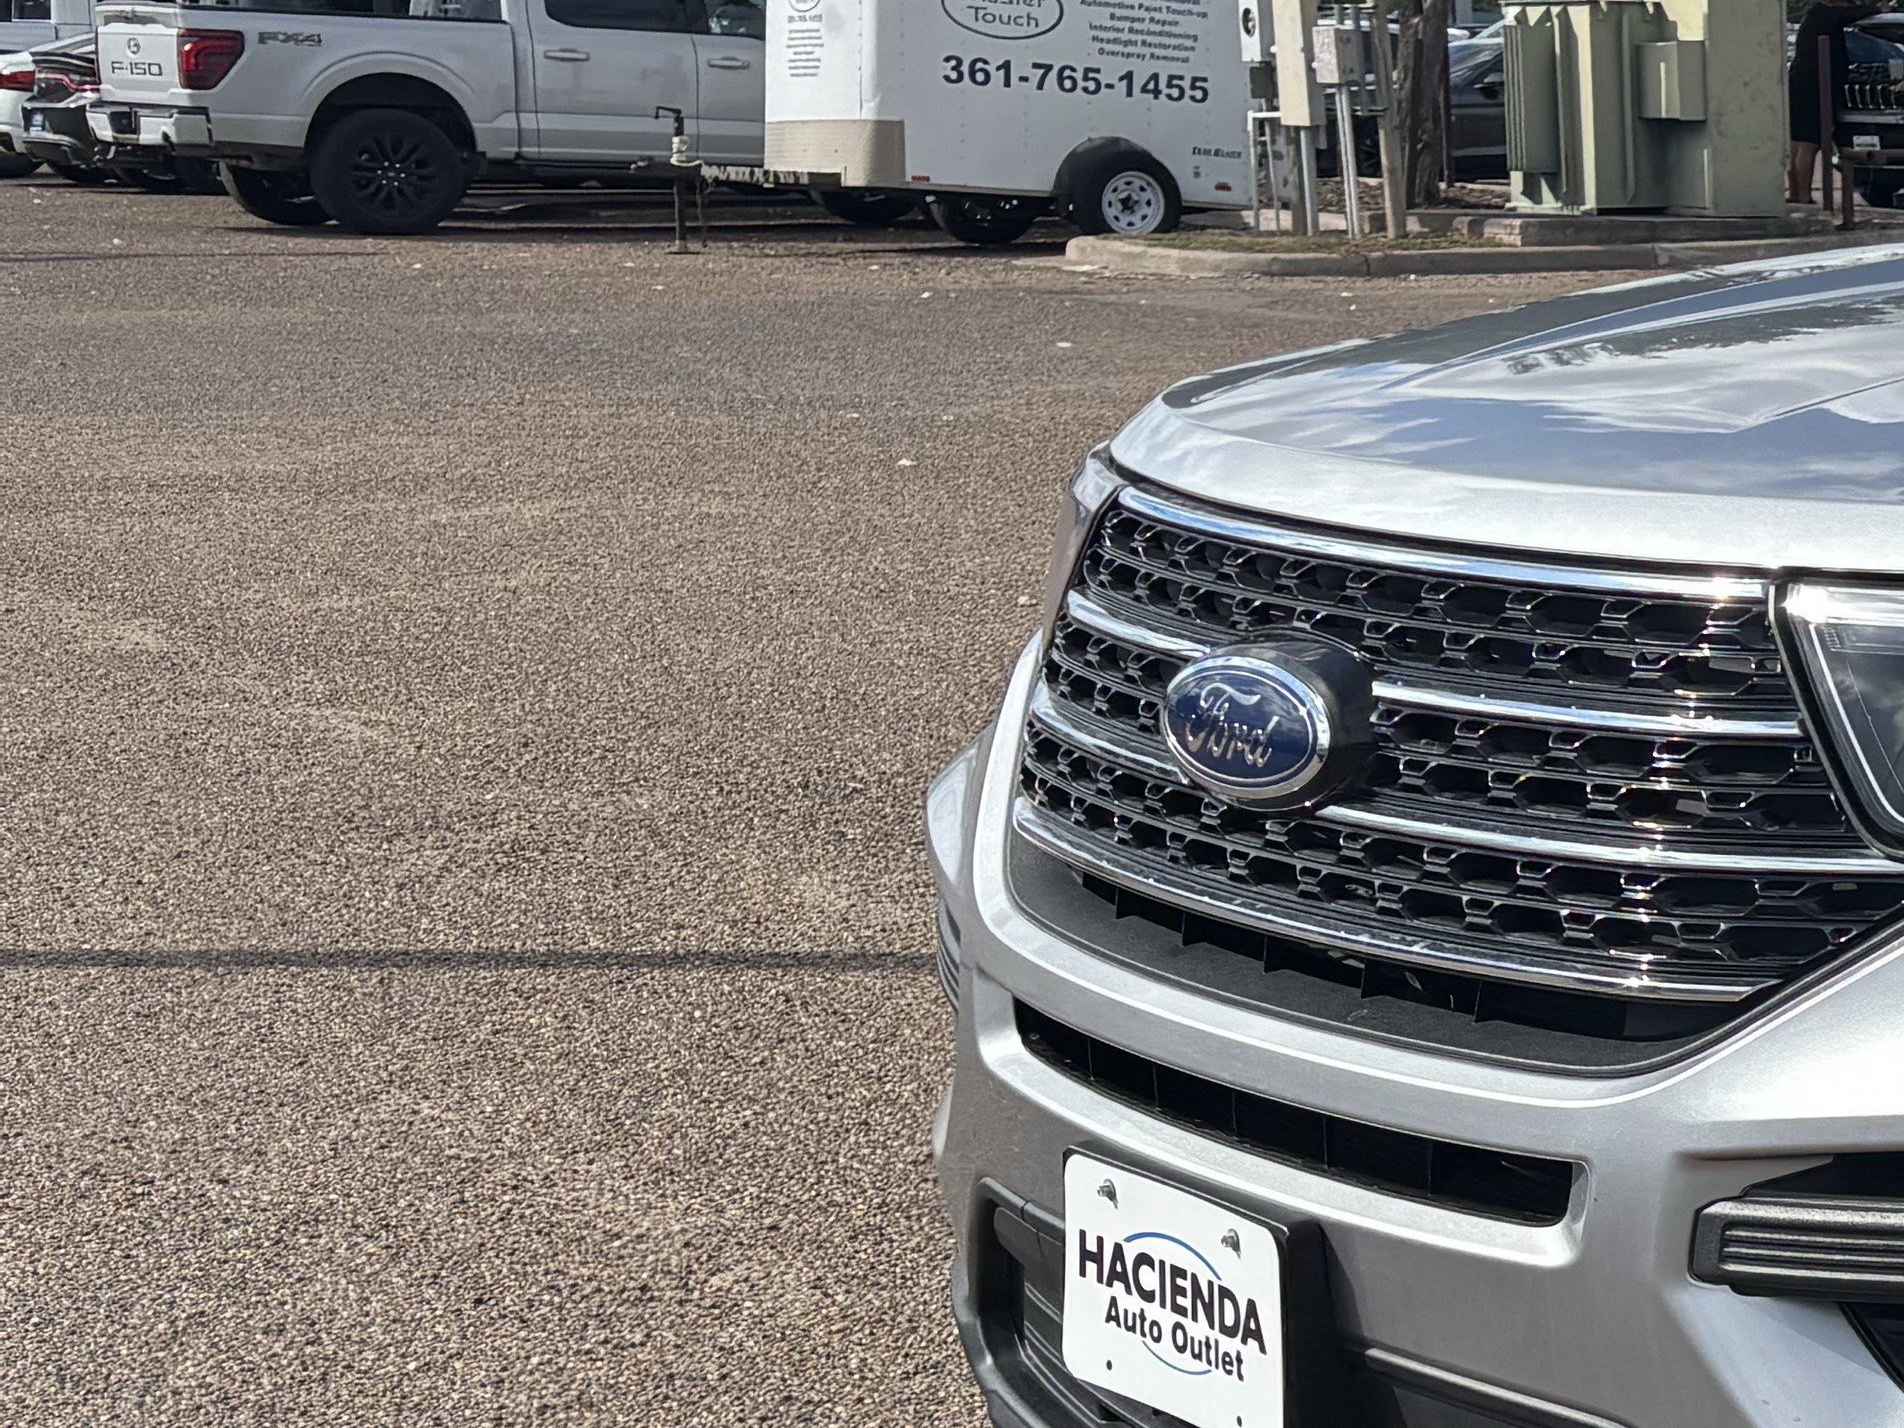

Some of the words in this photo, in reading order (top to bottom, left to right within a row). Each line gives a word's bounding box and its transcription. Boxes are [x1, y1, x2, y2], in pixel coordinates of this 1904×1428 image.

[967, 5, 1040, 29] Touch
[111, 61, 163, 76] F-150
[942, 54, 1209, 104] 361-765-1455
[1186, 681, 1280, 769] Ford
[1078, 1228, 1268, 1356] HACIENDA
[1104, 1295, 1163, 1344] Auto
[1171, 1320, 1245, 1383] Outlet
